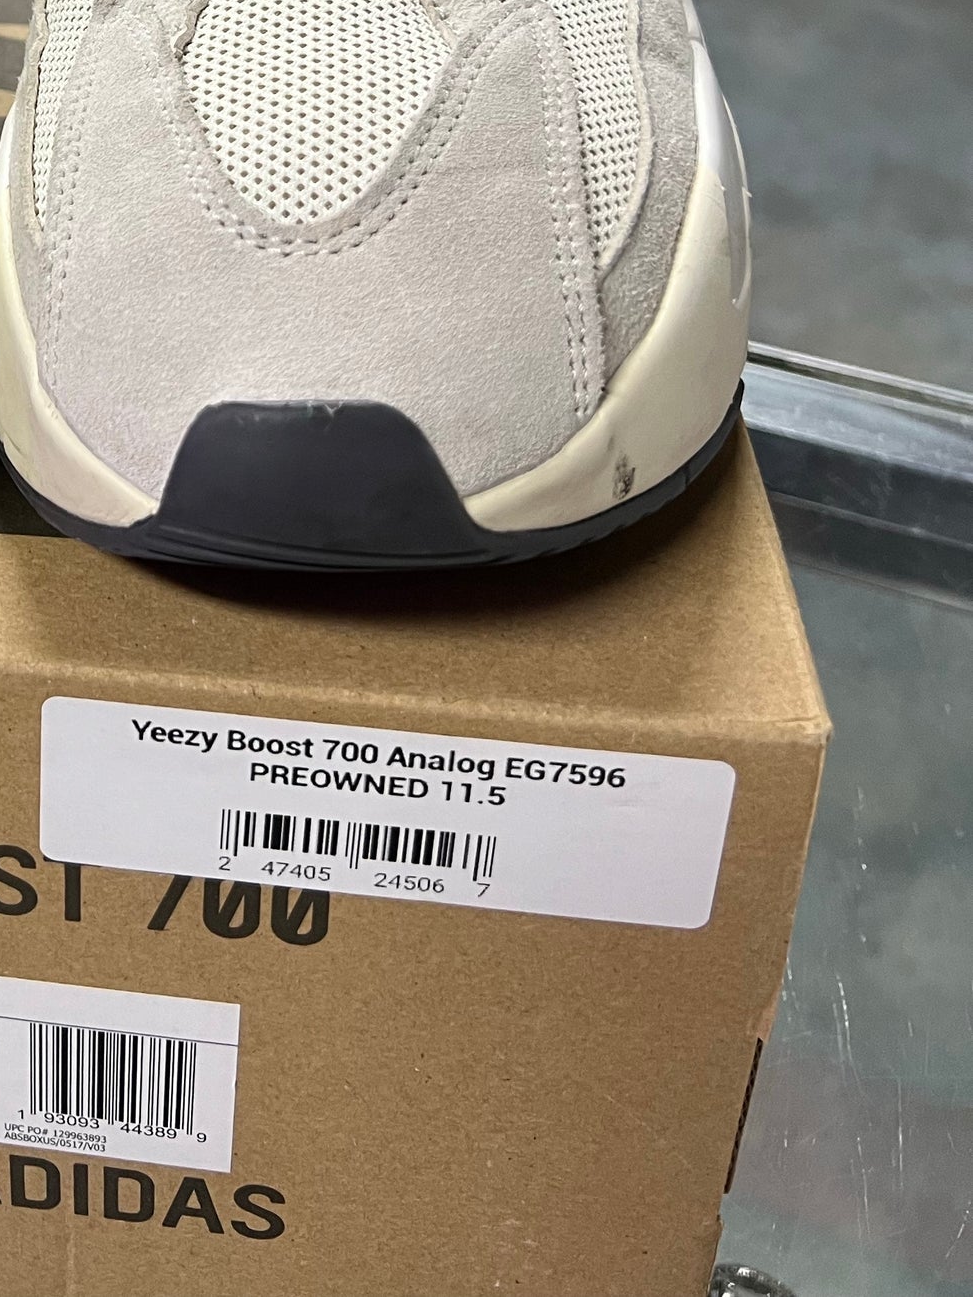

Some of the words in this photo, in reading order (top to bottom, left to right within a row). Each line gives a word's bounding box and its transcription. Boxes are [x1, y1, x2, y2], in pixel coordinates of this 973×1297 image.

[132, 719, 218, 753] Yeezy
[227, 730, 314, 758] Boost
[322, 739, 378, 762] 700
[387, 746, 495, 780] Analog
[505, 757, 626, 788] EG7596
[250, 762, 429, 798] PREOWNED
[441, 781, 507, 806] 11.5
[218, 856, 231, 871] 2
[261, 861, 332, 882] 47405
[374, 873, 445, 893] 24506
[477, 882, 490, 897] 7
[4, 1123, 25, 1133] UPC
[28, 1126, 48, 1135] PO#
[53, 1129, 107, 1143] 129963893
[17, 1109, 25, 1120] 1
[44, 1112, 100, 1129] 93093
[120, 1123, 177, 1139] 44389
[196, 1132, 207, 1143] 9
